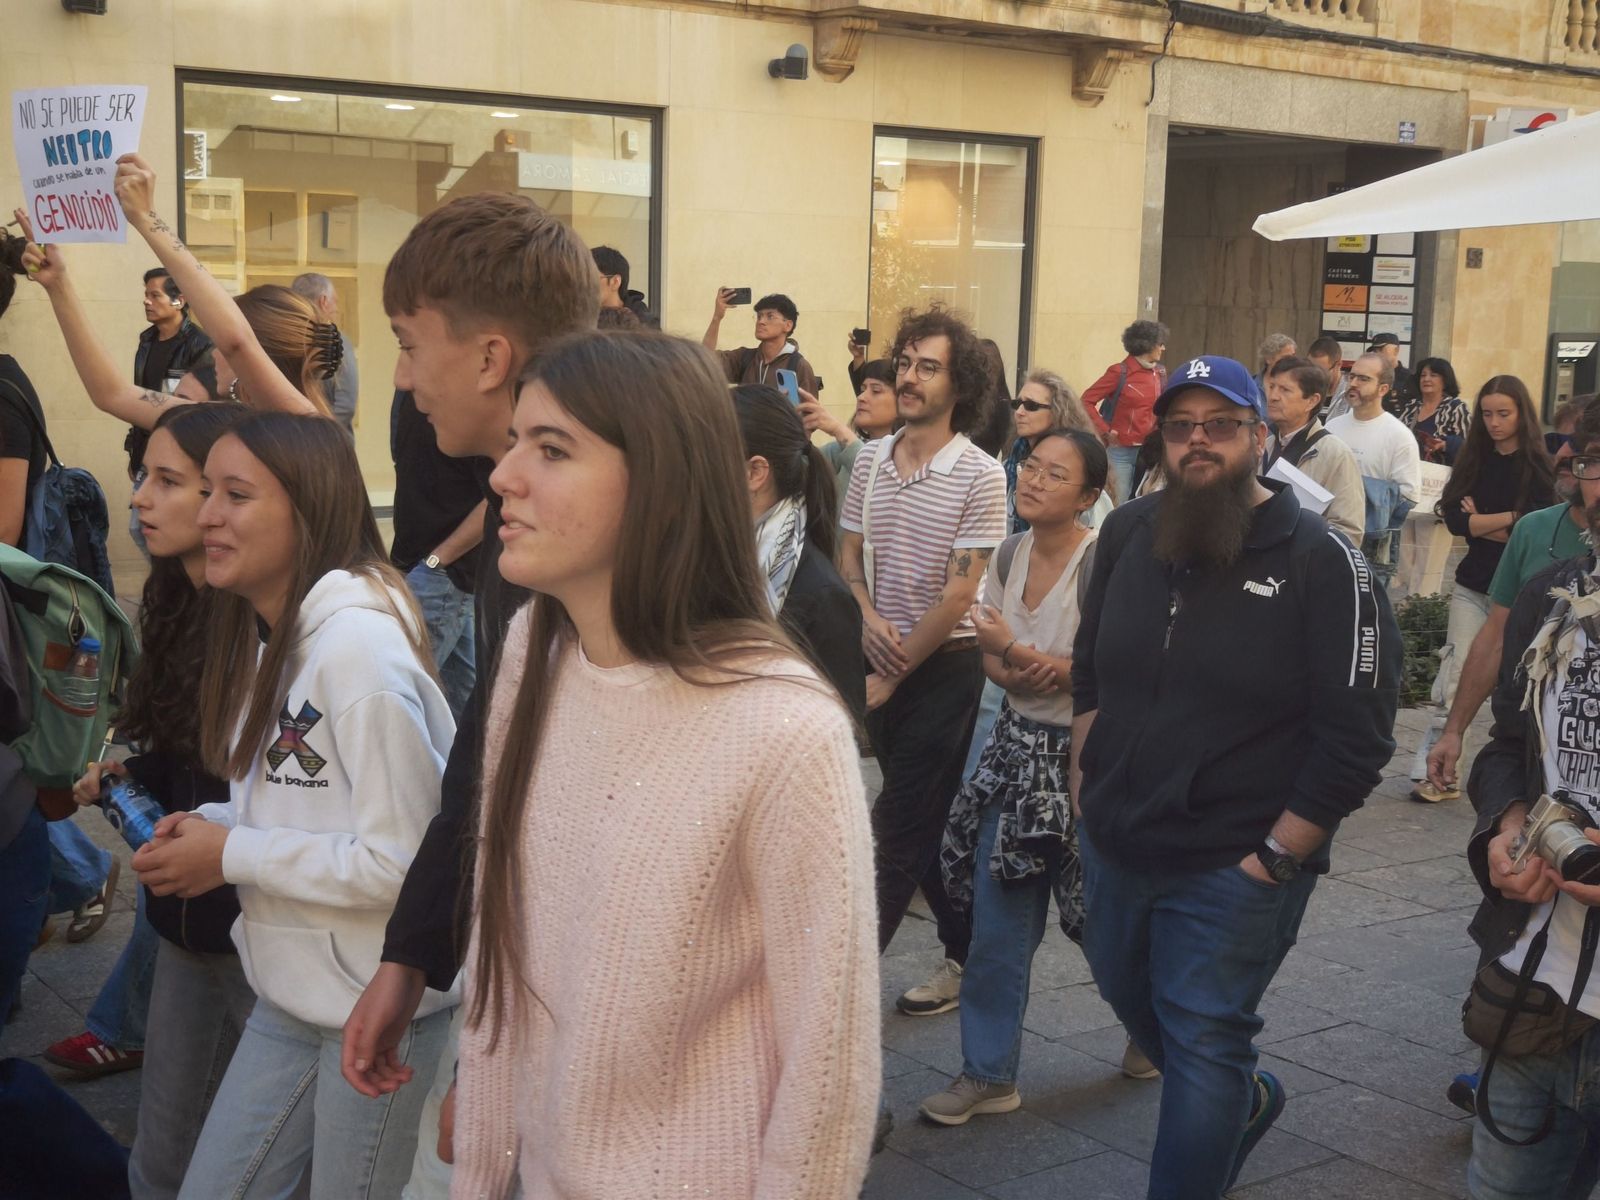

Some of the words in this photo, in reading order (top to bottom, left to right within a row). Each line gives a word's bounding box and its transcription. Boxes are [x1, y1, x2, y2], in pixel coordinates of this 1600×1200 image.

[19, 99, 36, 129] NO
[41, 97, 54, 128] SE
[60, 95, 102, 127] PUEDE
[105, 93, 136, 122] SER
[42, 129, 113, 167] NEUTRO
[55, 173, 64, 183] se
[84, 166, 93, 176] de
[1186, 358, 1211, 379] LA
[1350, 548, 1370, 593] PUMA
[1243, 580, 1275, 597] PUMA
[1358, 626, 1375, 673] PUMA
[1571, 692, 1600, 718] TO
[265, 770, 282, 784] blue
[285, 774, 329, 788] banana
